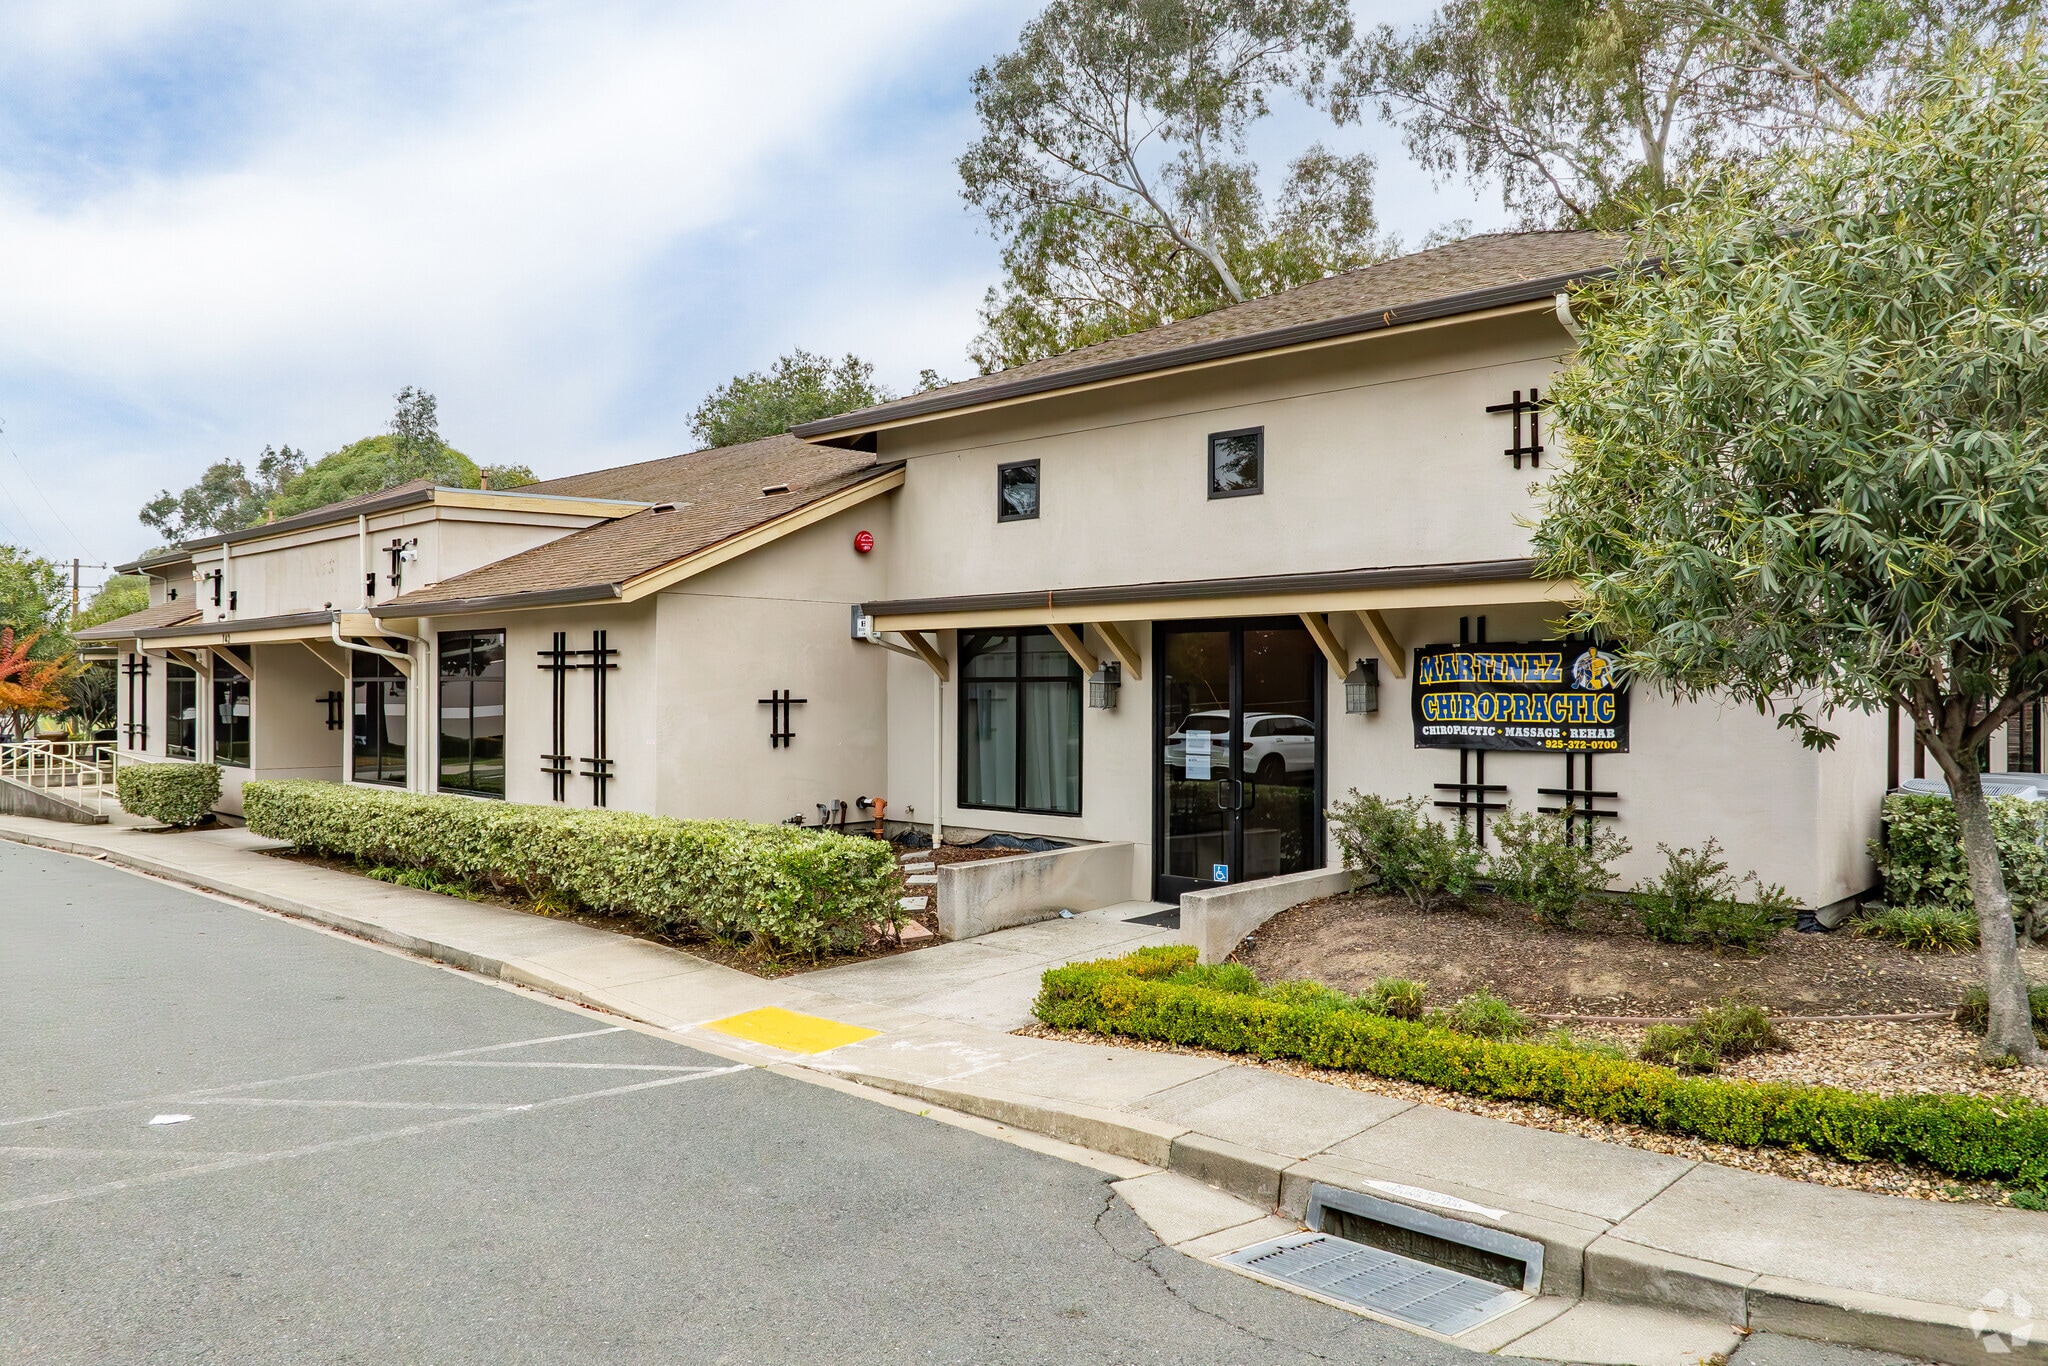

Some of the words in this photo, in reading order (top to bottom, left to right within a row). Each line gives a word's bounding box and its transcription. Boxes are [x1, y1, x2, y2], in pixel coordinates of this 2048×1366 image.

[1420, 653, 1563, 685] MARTINEZ
[1422, 692, 1616, 723] CHIROPRACTIC
[1422, 725, 1496, 737] CHIROPACTIC
[1505, 727, 1560, 738] MASSAGE
[1569, 729, 1616, 740] REHAB
[1545, 740, 1617, 750] 925-372-0700
